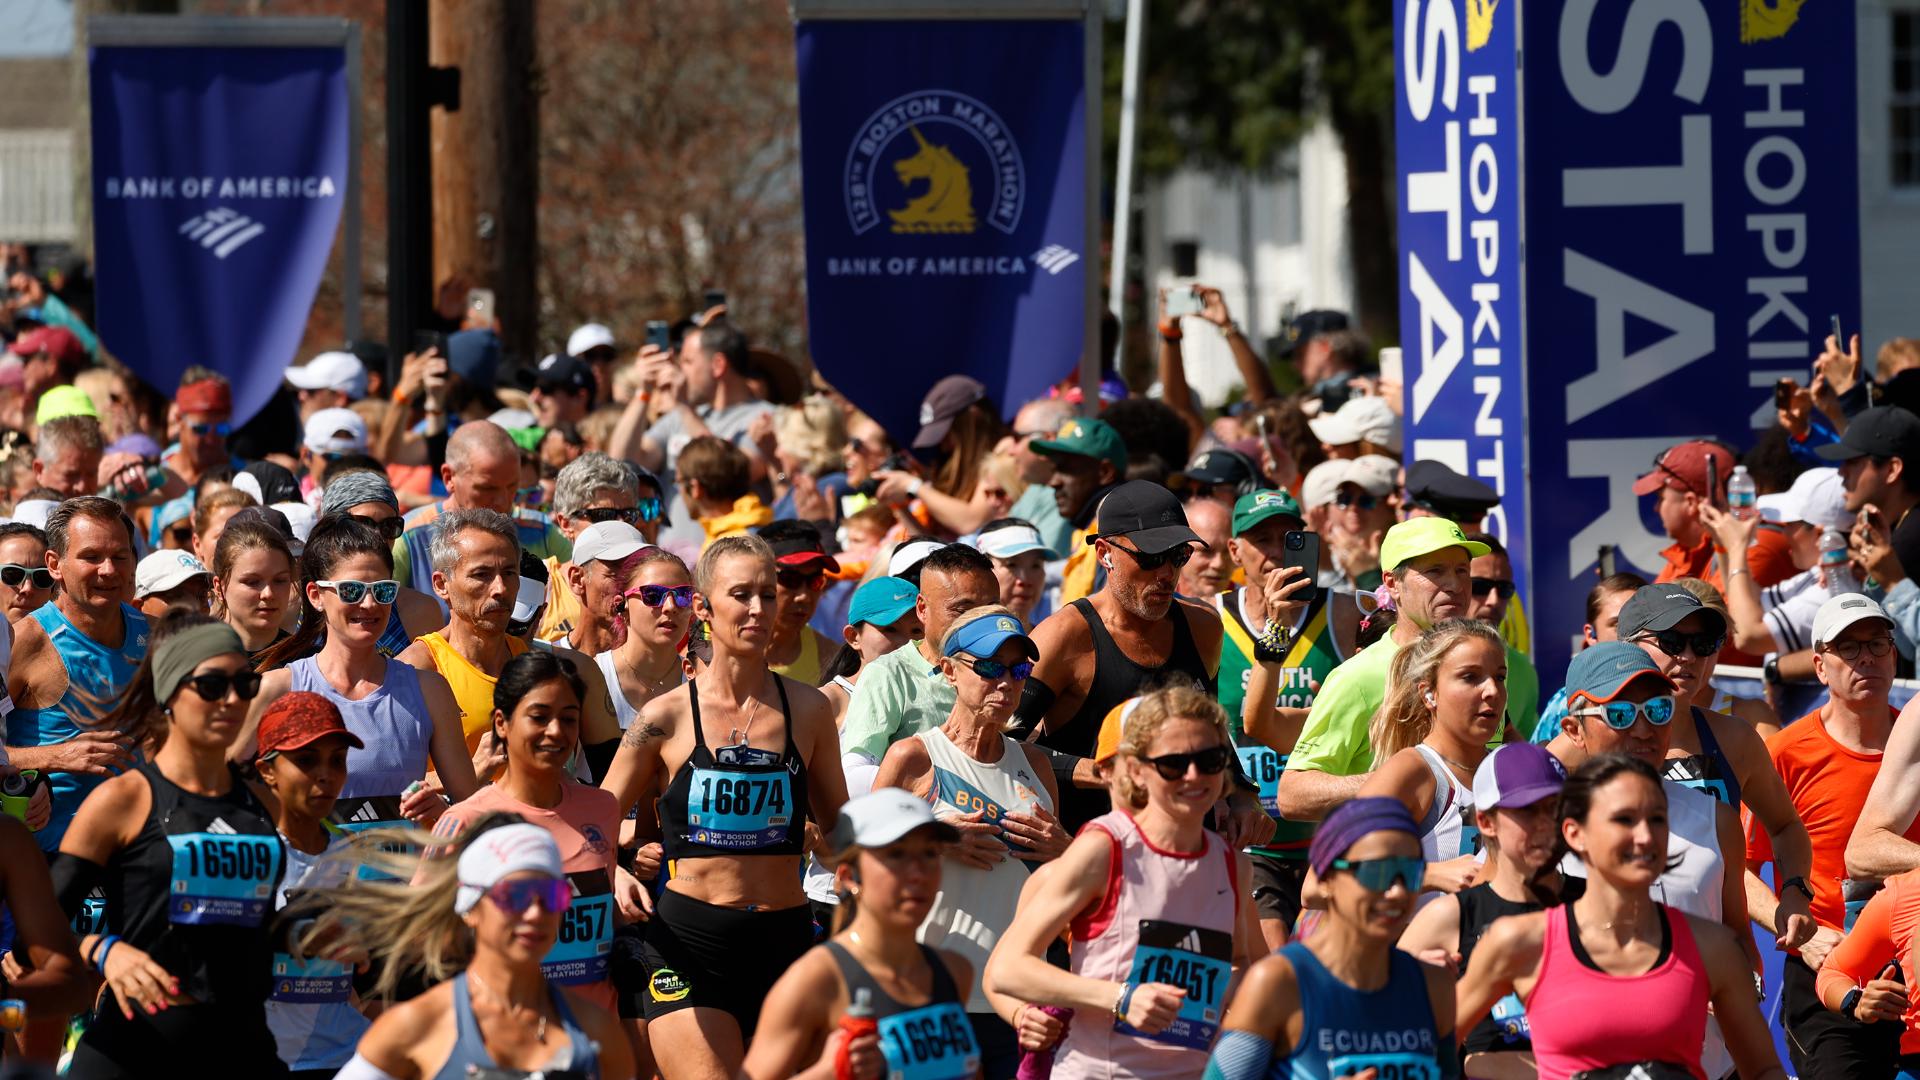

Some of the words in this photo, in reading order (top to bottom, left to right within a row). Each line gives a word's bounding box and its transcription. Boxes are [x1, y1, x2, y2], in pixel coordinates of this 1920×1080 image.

[859, 98, 940, 156] BOSTON
[952, 100, 1018, 219] MARATHON
[106, 176, 175, 199] BANK
[180, 176, 214, 199] OF
[218, 176, 336, 199] AMERICA
[827, 257, 881, 275] BANK
[887, 256, 919, 275] OF
[922, 256, 1027, 275] AMERICA
[701, 777, 785, 816] 16874
[955, 789, 998, 819] BOS
[184, 839, 271, 881] 16509
[556, 901, 608, 944] 657
[556, 962, 586, 972] BOSTON
[1140, 953, 1219, 1005] 16451
[889, 1011, 972, 1067] 16645
[1317, 1028, 1433, 1053] ECUADOR
